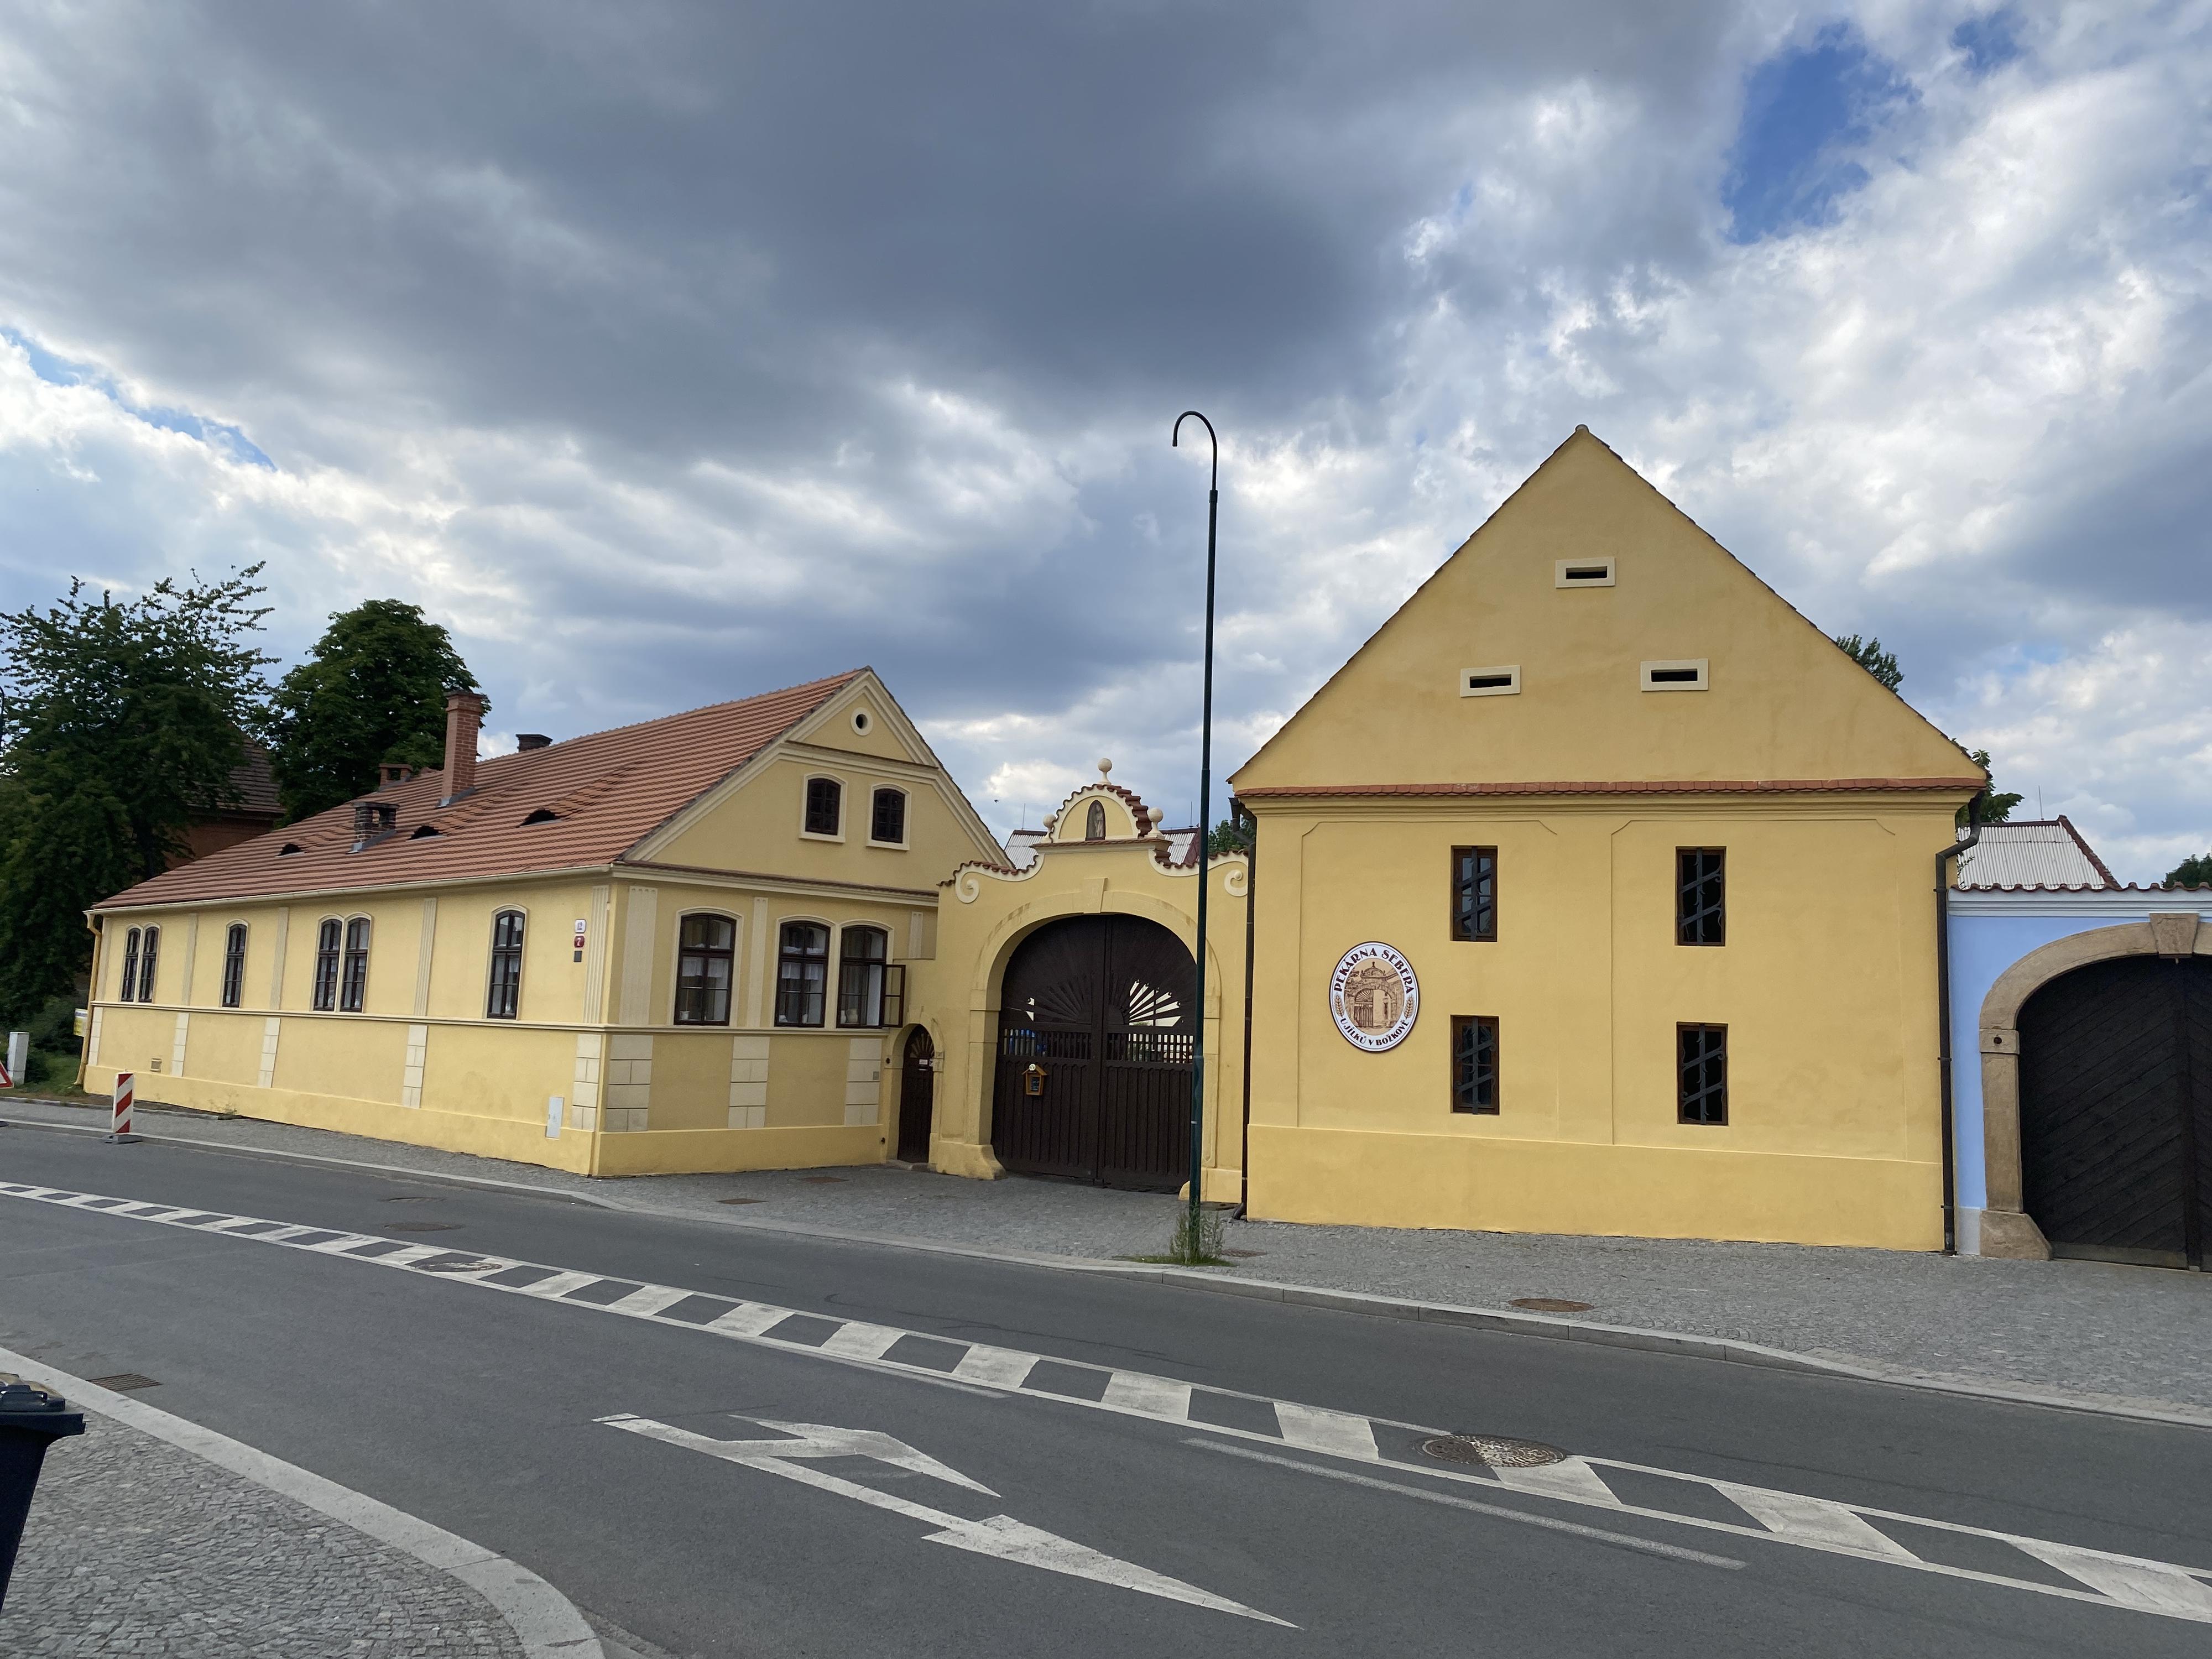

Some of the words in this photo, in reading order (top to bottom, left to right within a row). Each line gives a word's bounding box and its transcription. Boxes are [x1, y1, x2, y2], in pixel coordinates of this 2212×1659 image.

[1334, 947, 1378, 992] PEKÁRNA
[1381, 950, 1415, 994] SEBERA
[1343, 1025, 1367, 1044] JÍLKŮ
[1376, 1019, 1410, 1046] BOŽKOVĚ
